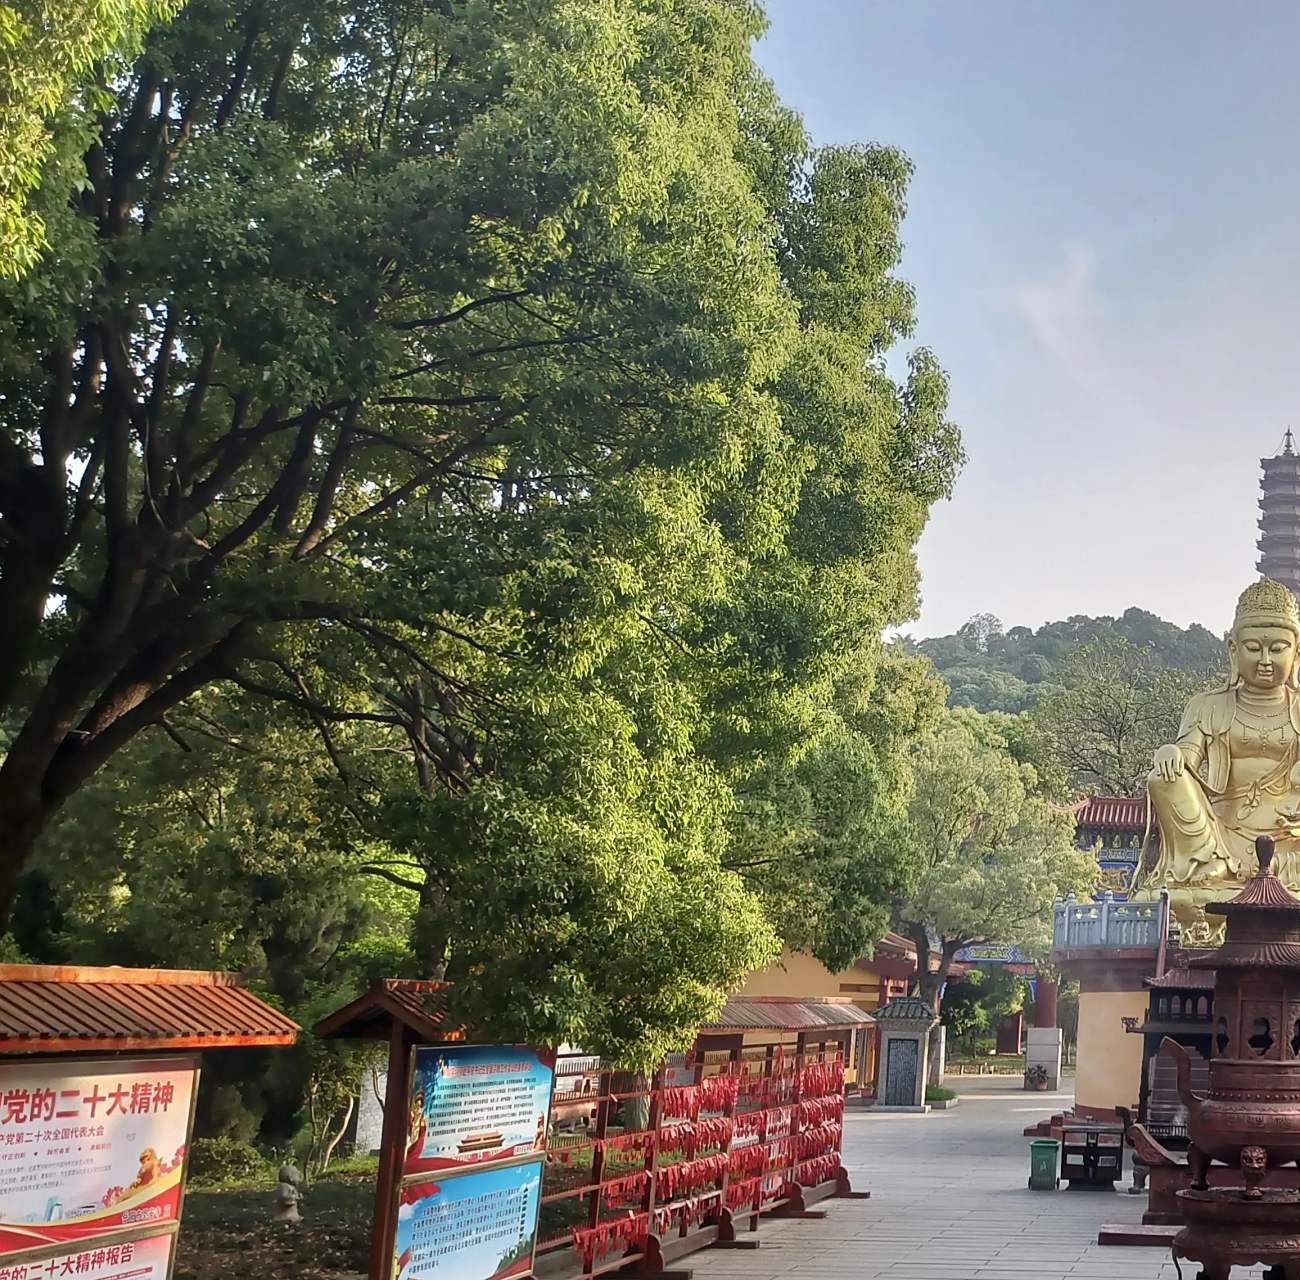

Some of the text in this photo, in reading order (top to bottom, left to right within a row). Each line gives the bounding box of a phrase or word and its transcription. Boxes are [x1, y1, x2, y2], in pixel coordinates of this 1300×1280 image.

[0, 1081, 174, 1125] 党的二十大精神
